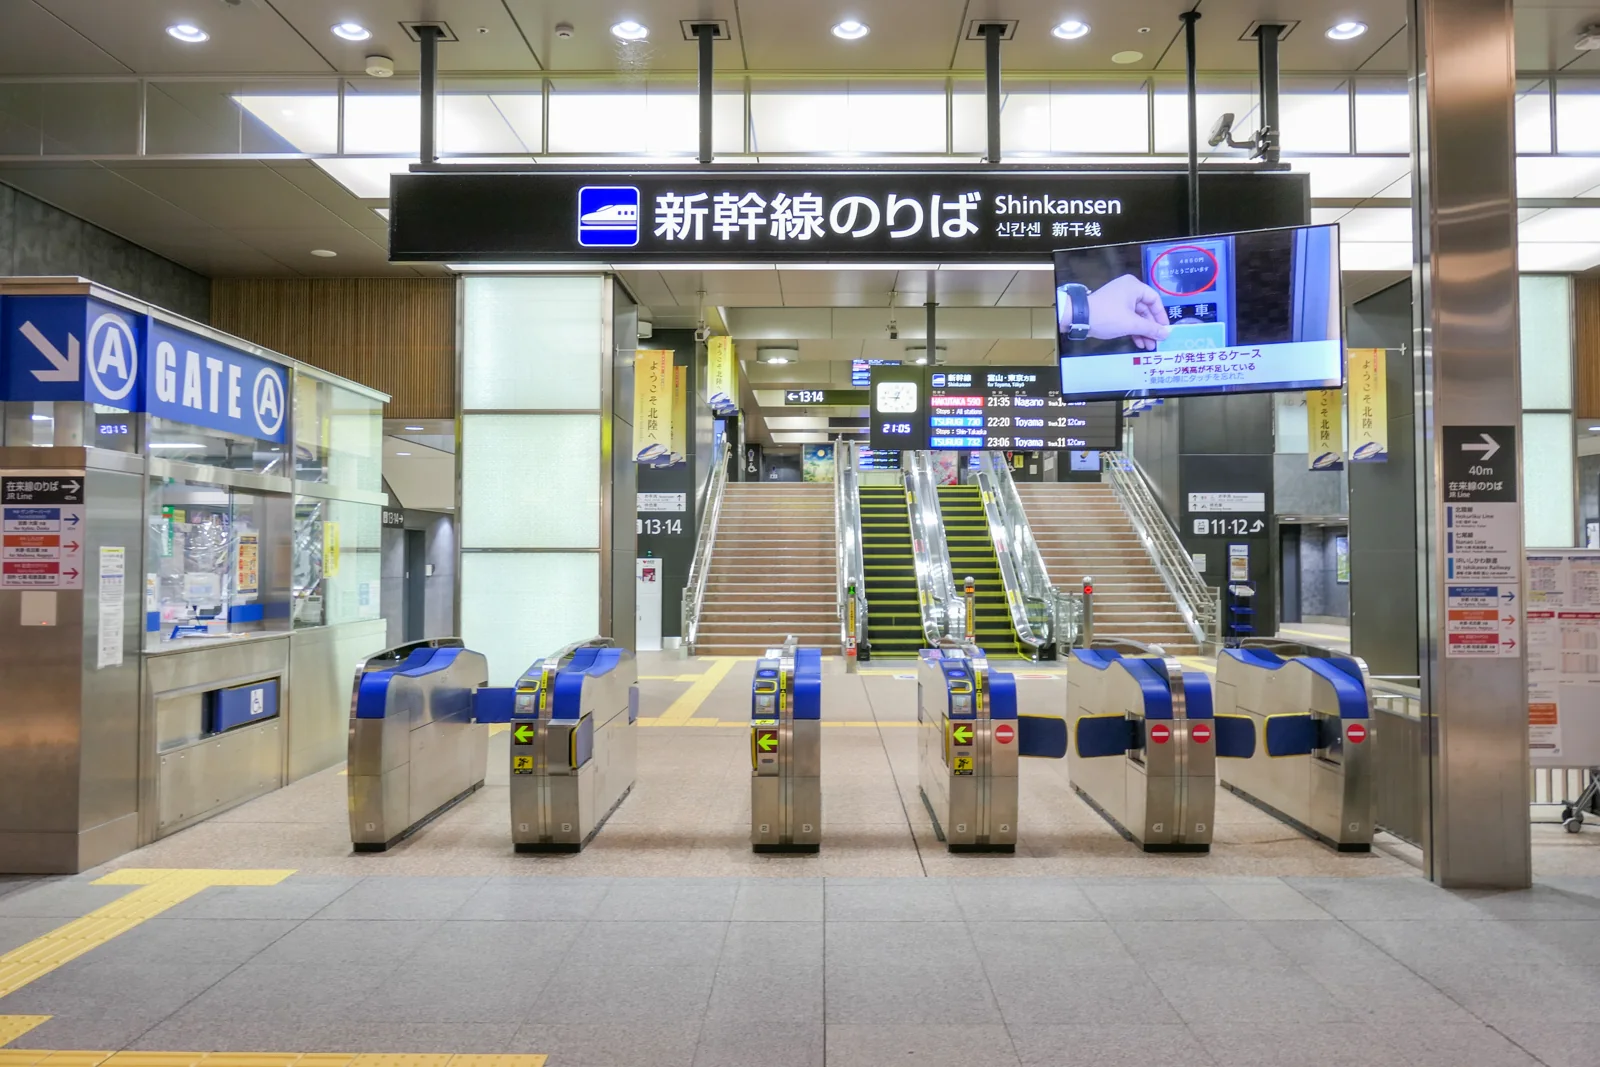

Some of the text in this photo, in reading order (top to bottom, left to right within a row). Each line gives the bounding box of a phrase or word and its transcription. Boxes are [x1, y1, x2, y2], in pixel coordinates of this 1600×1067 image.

[995, 194, 1121, 215] Shinkansen
[655, 192, 981, 240] 新幹線のりば
[996, 222, 1041, 237] 신칸센
[1052, 222, 1102, 237] 新干线
[98, 326, 128, 379] A
[156, 341, 278, 420] GATE A
[647, 361, 659, 441] ようこそ北陸へ
[988, 397, 1010, 407] 21:35
[1014, 398, 1045, 408] Nagano
[1362, 360, 1373, 438] ようこそ北陸へ
[883, 424, 911, 433] 21:05
[988, 417, 1010, 427] 22:20
[1014, 417, 1044, 427] Toyama
[988, 437, 1010, 447] 23:06
[1014, 437, 1044, 447] Toyama
[1469, 465, 1493, 476] 40m
[6, 481, 60, 492] 在来線のりば
[1448, 481, 1504, 491] 在来線のりば
